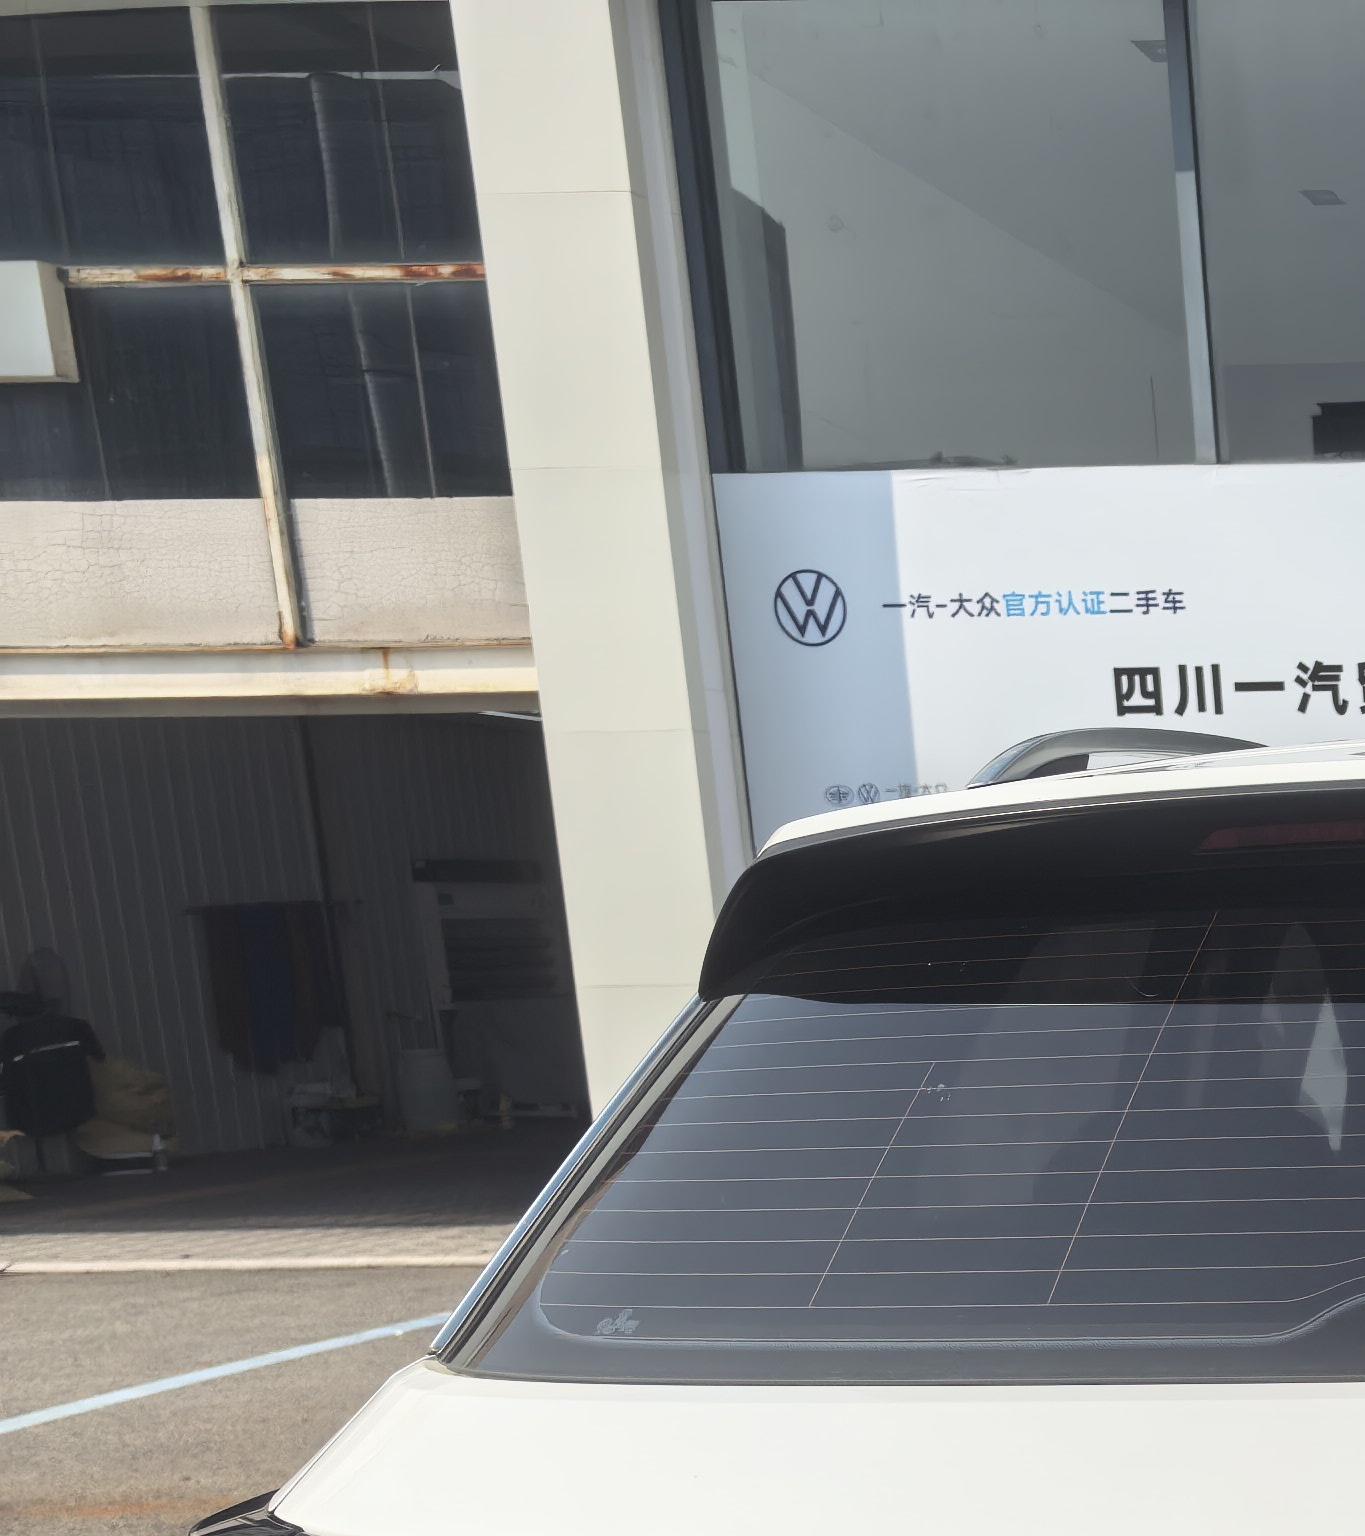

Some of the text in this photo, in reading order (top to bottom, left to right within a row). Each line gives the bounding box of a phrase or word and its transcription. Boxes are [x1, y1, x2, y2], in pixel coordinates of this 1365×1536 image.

[882, 588, 1186, 620] 一汽-大众官方认证二手车
